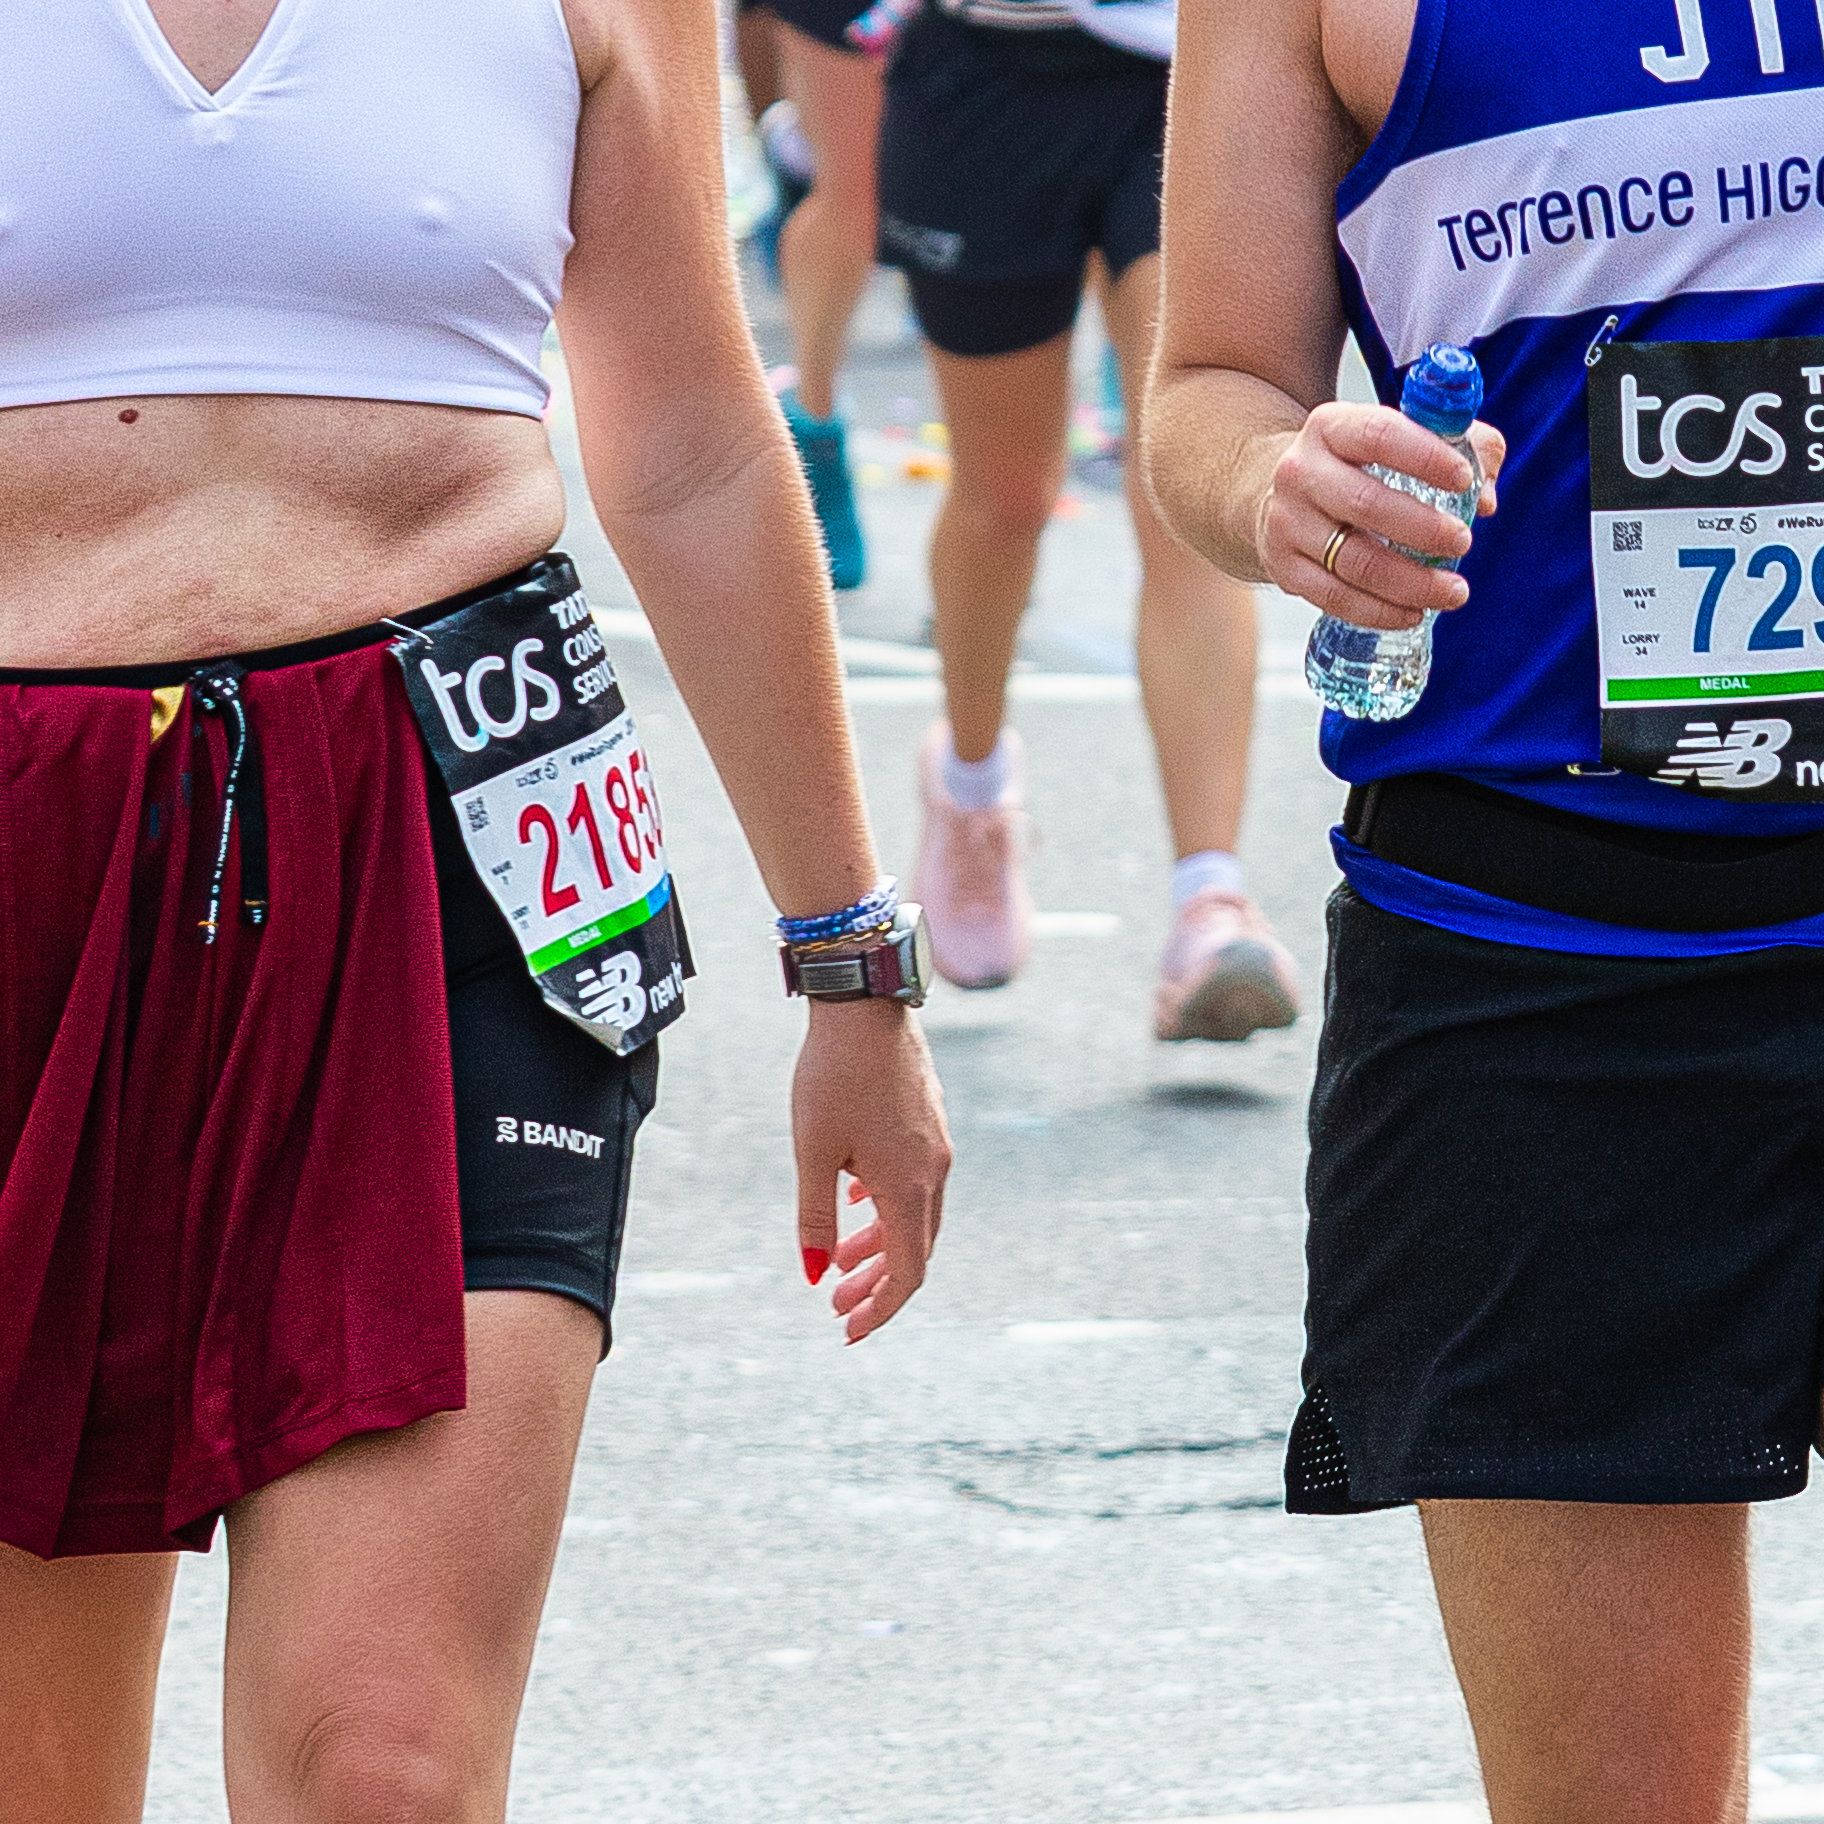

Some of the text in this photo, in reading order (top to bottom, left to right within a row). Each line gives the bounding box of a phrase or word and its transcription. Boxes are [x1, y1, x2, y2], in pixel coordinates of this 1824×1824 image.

[1620, 374, 1787, 478] tcs
[1622, 587, 1657, 598] WAVE
[1622, 633, 1660, 645] LORRY
[420, 638, 561, 752] tcs
[1700, 676, 1751, 691] MEDAL
[523, 1121, 605, 1158] BANDIT
